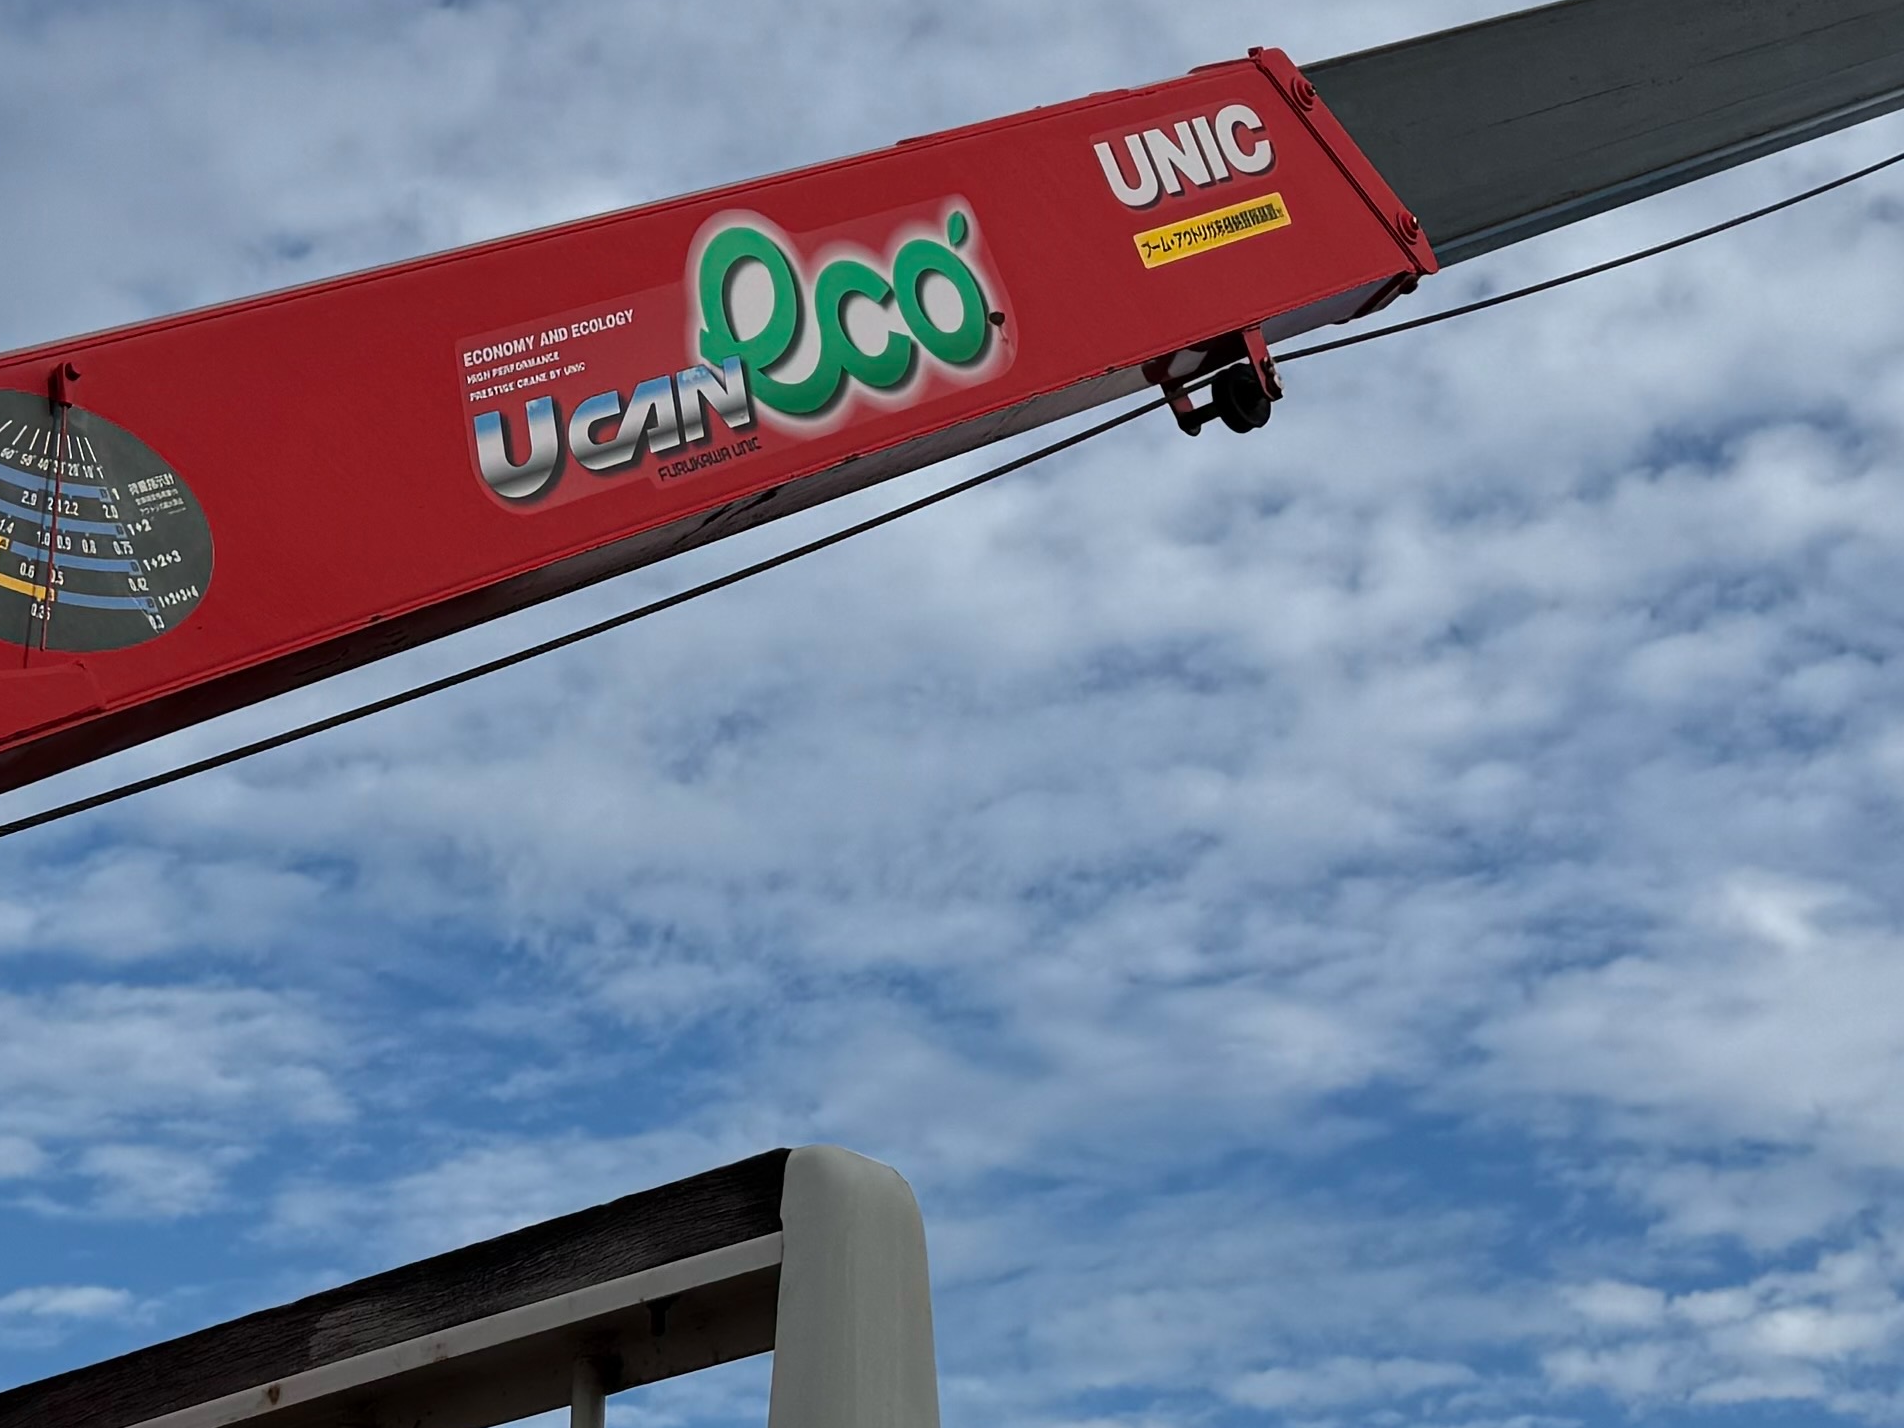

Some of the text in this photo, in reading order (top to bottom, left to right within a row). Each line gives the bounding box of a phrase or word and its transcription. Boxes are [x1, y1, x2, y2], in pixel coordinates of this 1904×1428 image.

[1093, 104, 1272, 207] UNIC
[698, 226, 989, 414] eco
[463, 308, 635, 368] ECONOMY AND ECOLOGY
[492, 351, 560, 378] PERFORMANCE
[469, 362, 587, 402] PRESTIGE CRANE BY UNIC
[658, 436, 762, 482] FURUKAWA UNIC
[21, 490, 38, 506] 2.9
[64, 500, 79, 516] 2.2
[102, 504, 119, 519] 2.0
[36, 531, 51, 546] 1.0
[56, 534, 72, 550] 0.9
[112, 540, 134, 556] 0.75
[143, 549, 182, 572] 1+2+3
[19, 561, 35, 579] 0.6
[128, 577, 150, 592] 0.42
[158, 584, 199, 609] 1+2+3+4
[148, 614, 165, 630] 0.3
